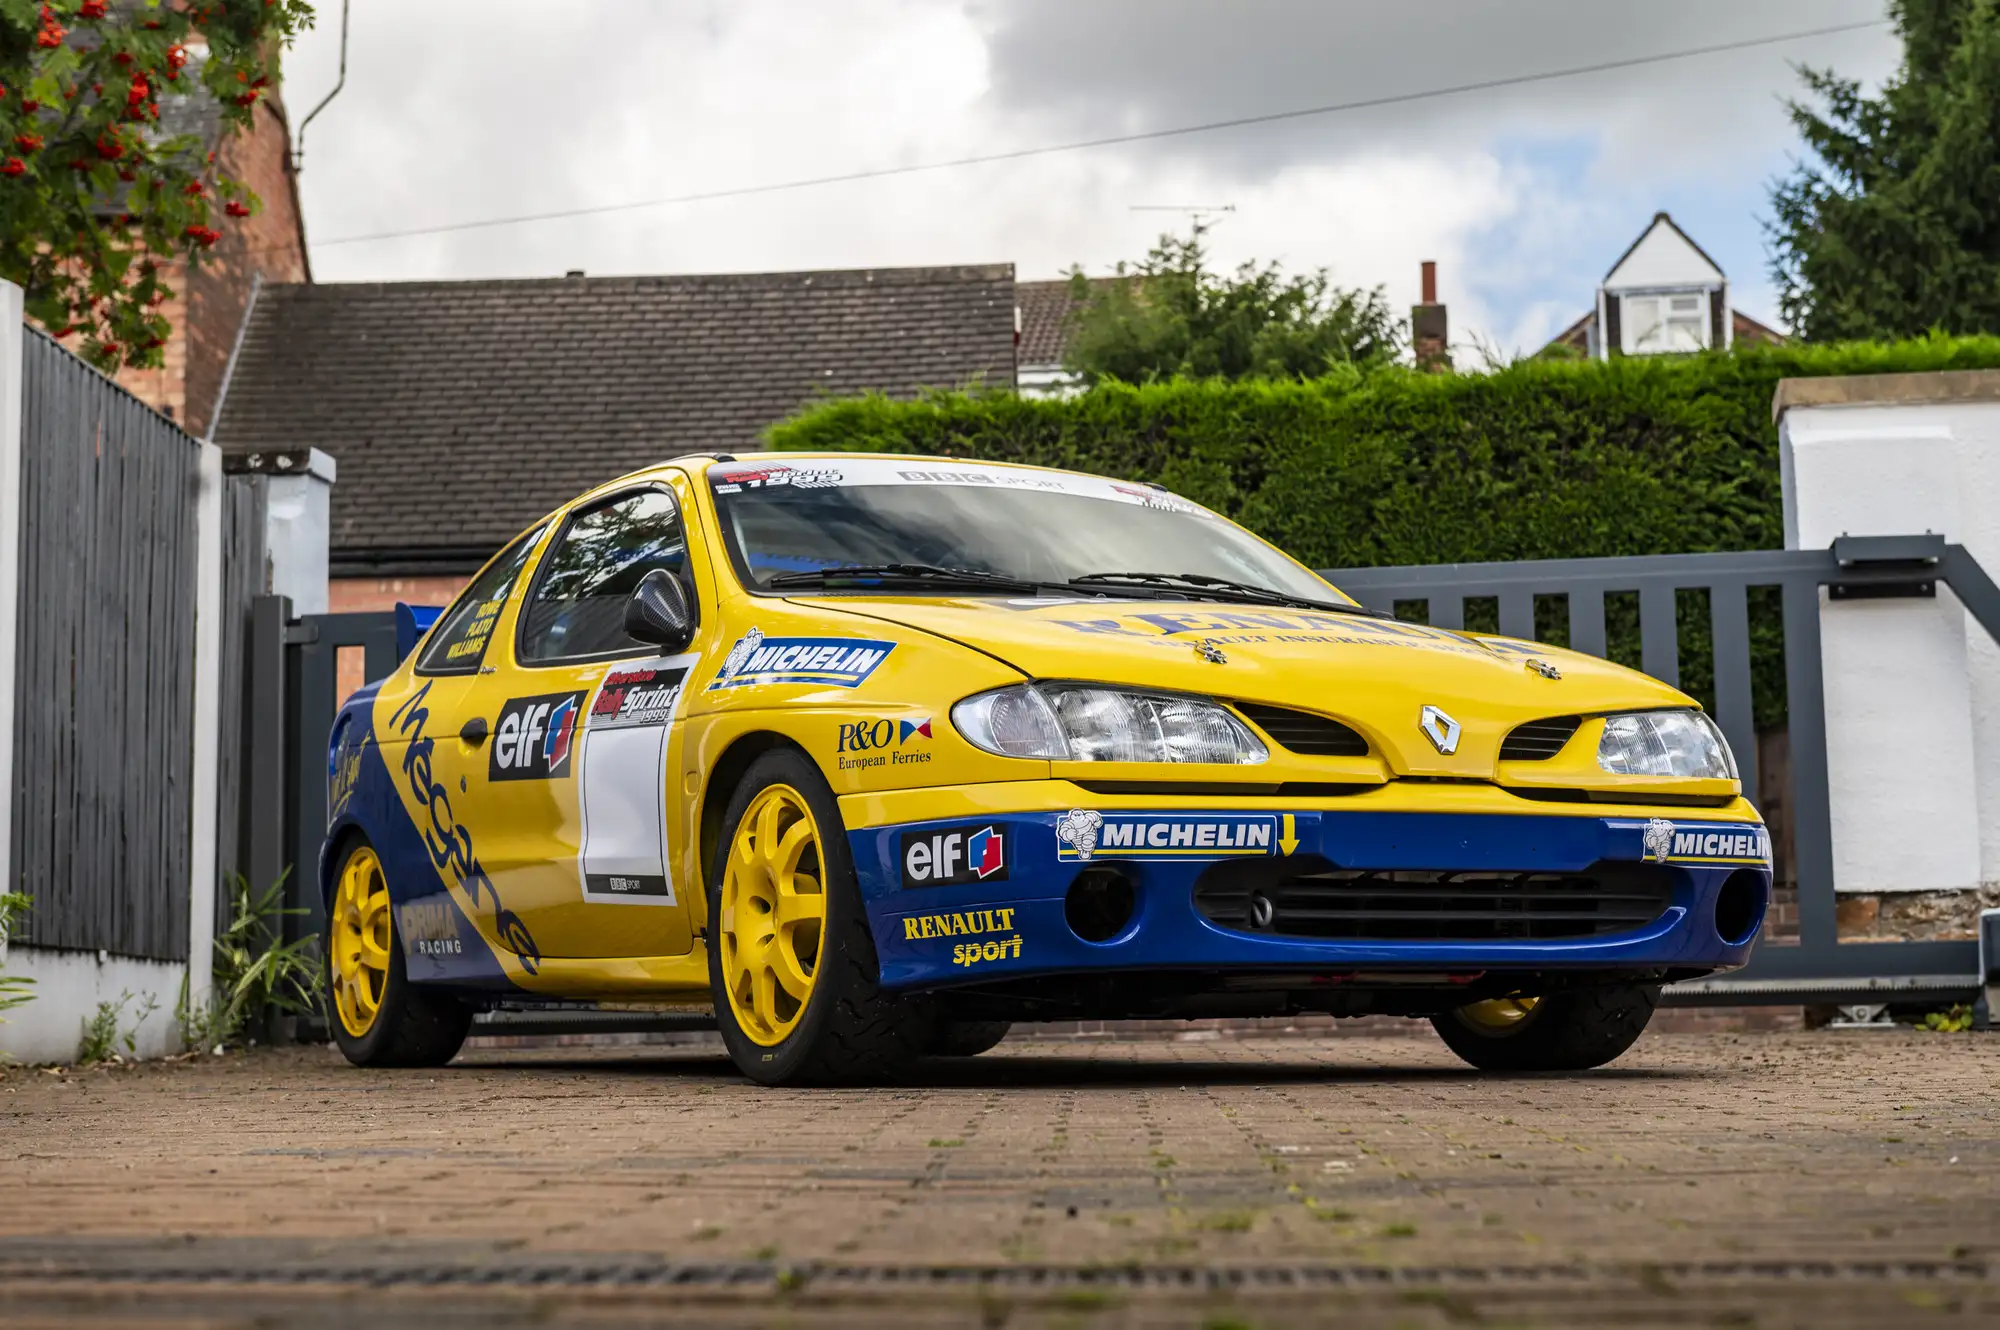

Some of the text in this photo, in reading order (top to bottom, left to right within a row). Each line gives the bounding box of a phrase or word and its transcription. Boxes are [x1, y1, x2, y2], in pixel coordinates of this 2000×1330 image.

[897, 471, 995, 484] BBC
[466, 618, 494, 638] PLATO
[447, 637, 486, 658] WILLIAMS
[743, 645, 886, 674] MICHELIN
[639, 708, 668, 724] 1999
[496, 703, 550, 769] elf
[836, 718, 894, 753] P&O
[838, 750, 932, 771] European Ferries
[1102, 822, 1271, 848] MICHELIN
[906, 834, 961, 879] elf
[400, 903, 459, 955] PRIMA
[903, 907, 1016, 941] RENAULT
[419, 940, 462, 955] RACING
[952, 932, 1024, 968] sport
